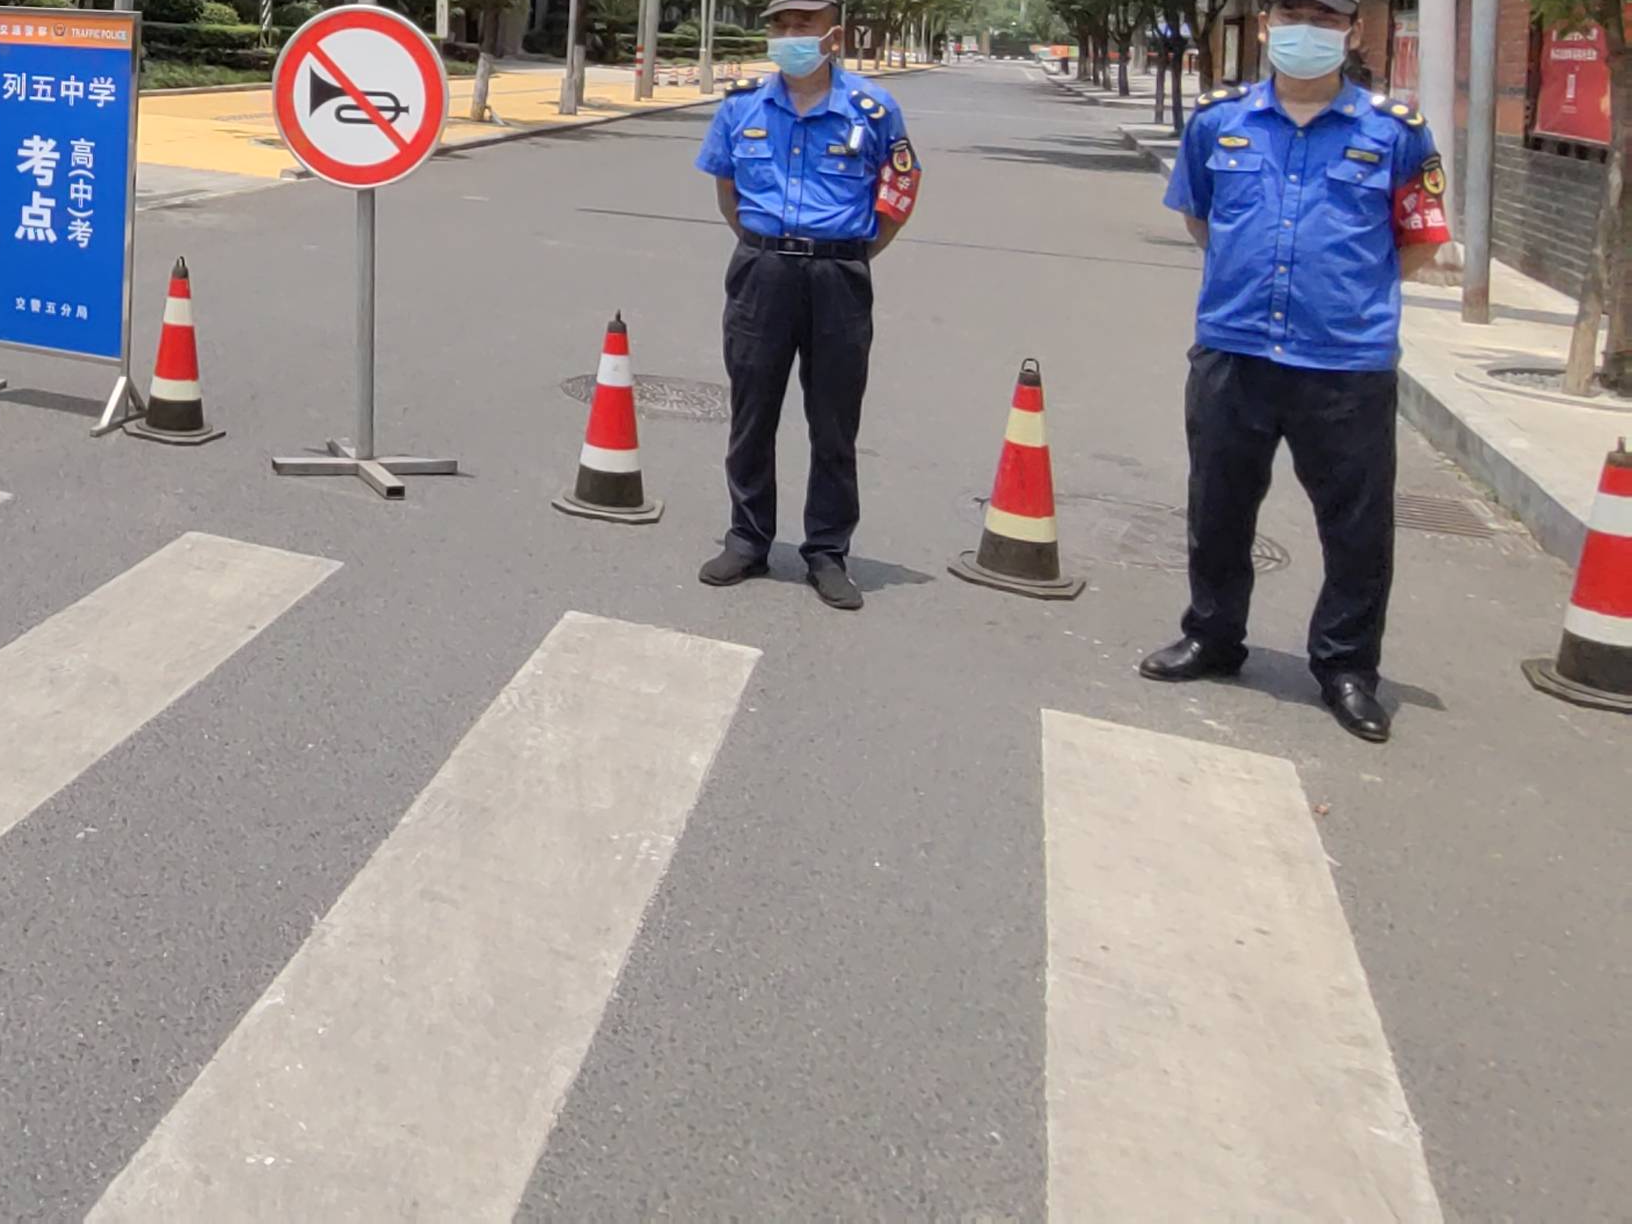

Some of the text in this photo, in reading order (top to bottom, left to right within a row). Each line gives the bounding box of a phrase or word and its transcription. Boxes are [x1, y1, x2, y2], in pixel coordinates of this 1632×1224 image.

[2, 72, 116, 108] 列五中学
[14, 134, 61, 243] 考点
[15, 296, 89, 321] 交警五分局
